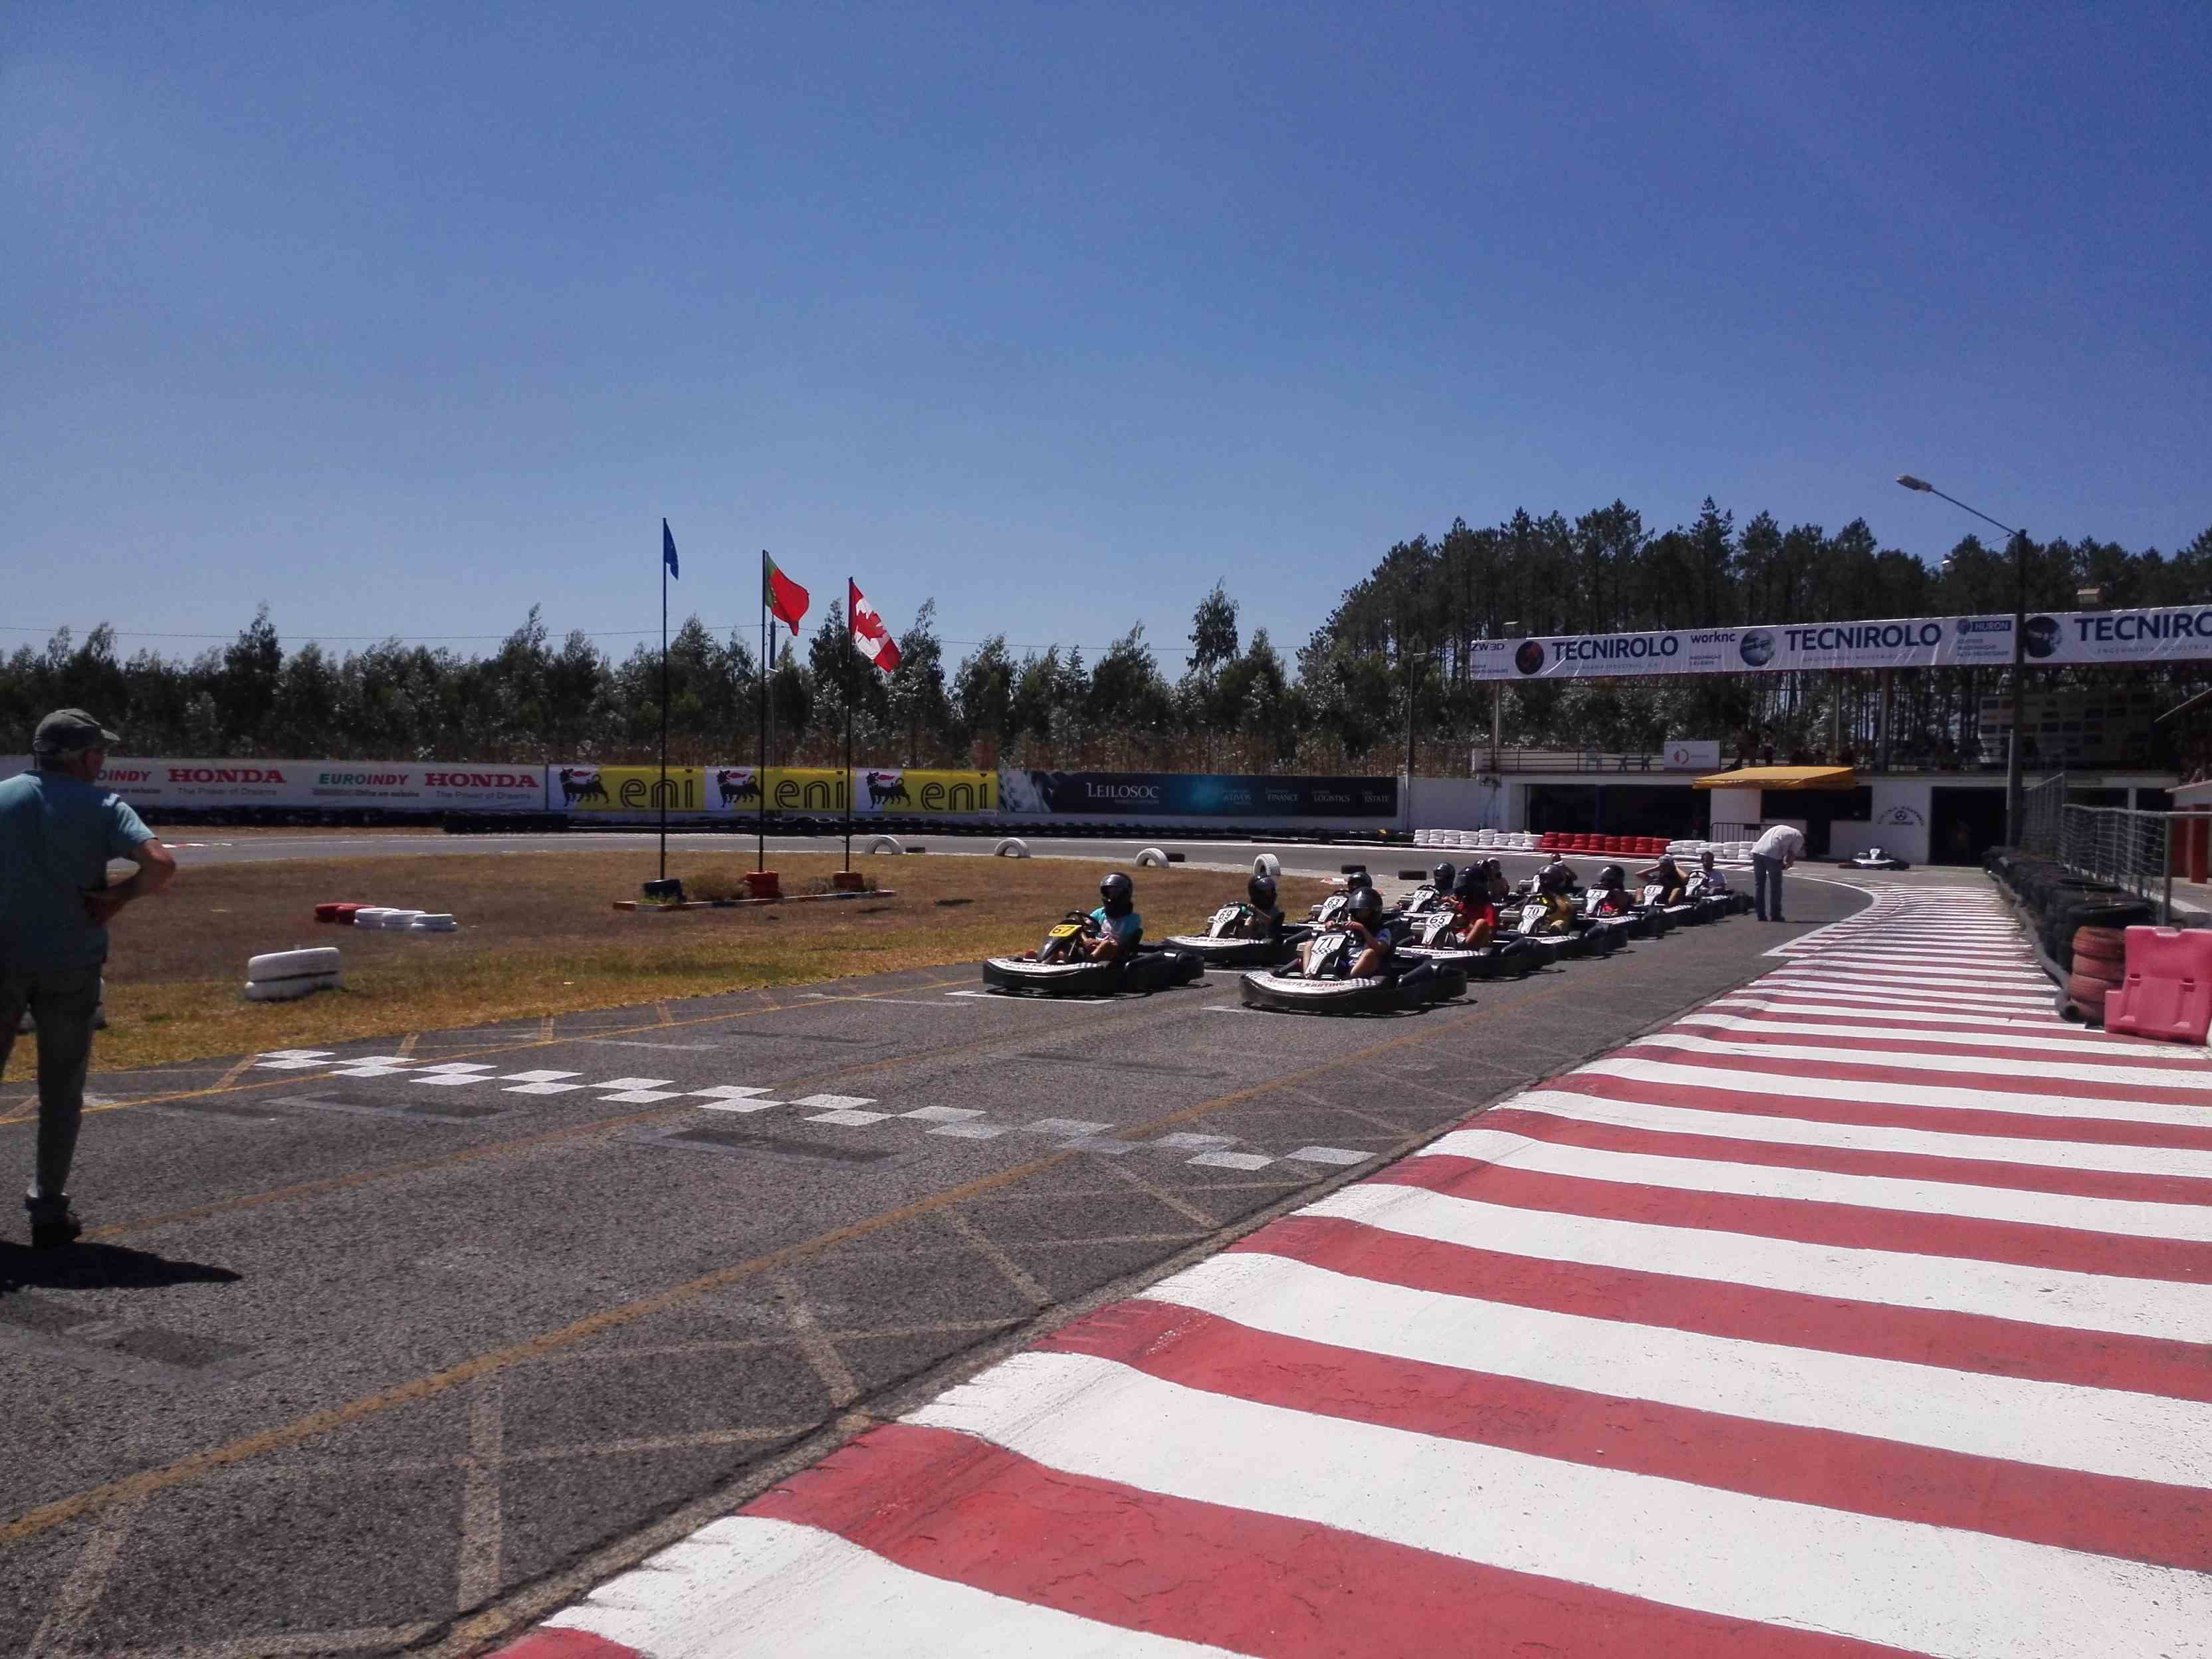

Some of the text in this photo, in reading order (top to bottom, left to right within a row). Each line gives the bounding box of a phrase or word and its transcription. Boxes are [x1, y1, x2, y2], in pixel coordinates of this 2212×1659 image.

[1975, 622, 2009, 631] HURON
[1690, 631, 1736, 643] worknc
[1784, 623, 1941, 651] TECNIROLO
[1552, 636, 1679, 661] TECNIROLO
[168, 769, 286, 783] HONDA
[318, 774, 409, 785] EUROINDY
[425, 773, 539, 788] HONDA
[178, 787, 195, 796] The
[619, 768, 693, 809] eni
[774, 770, 845, 810] eni
[921, 773, 988, 810] eni
[1085, 782, 1160, 798] LEILOSOC
[1266, 794, 1298, 802] FINANCE
[1313, 794, 1351, 803] LOGISTICS
[1218, 909, 1232, 920] 69
[1527, 907, 1540, 916] 70
[1430, 915, 1446, 924] 65
[1317, 938, 1334, 948] 71
